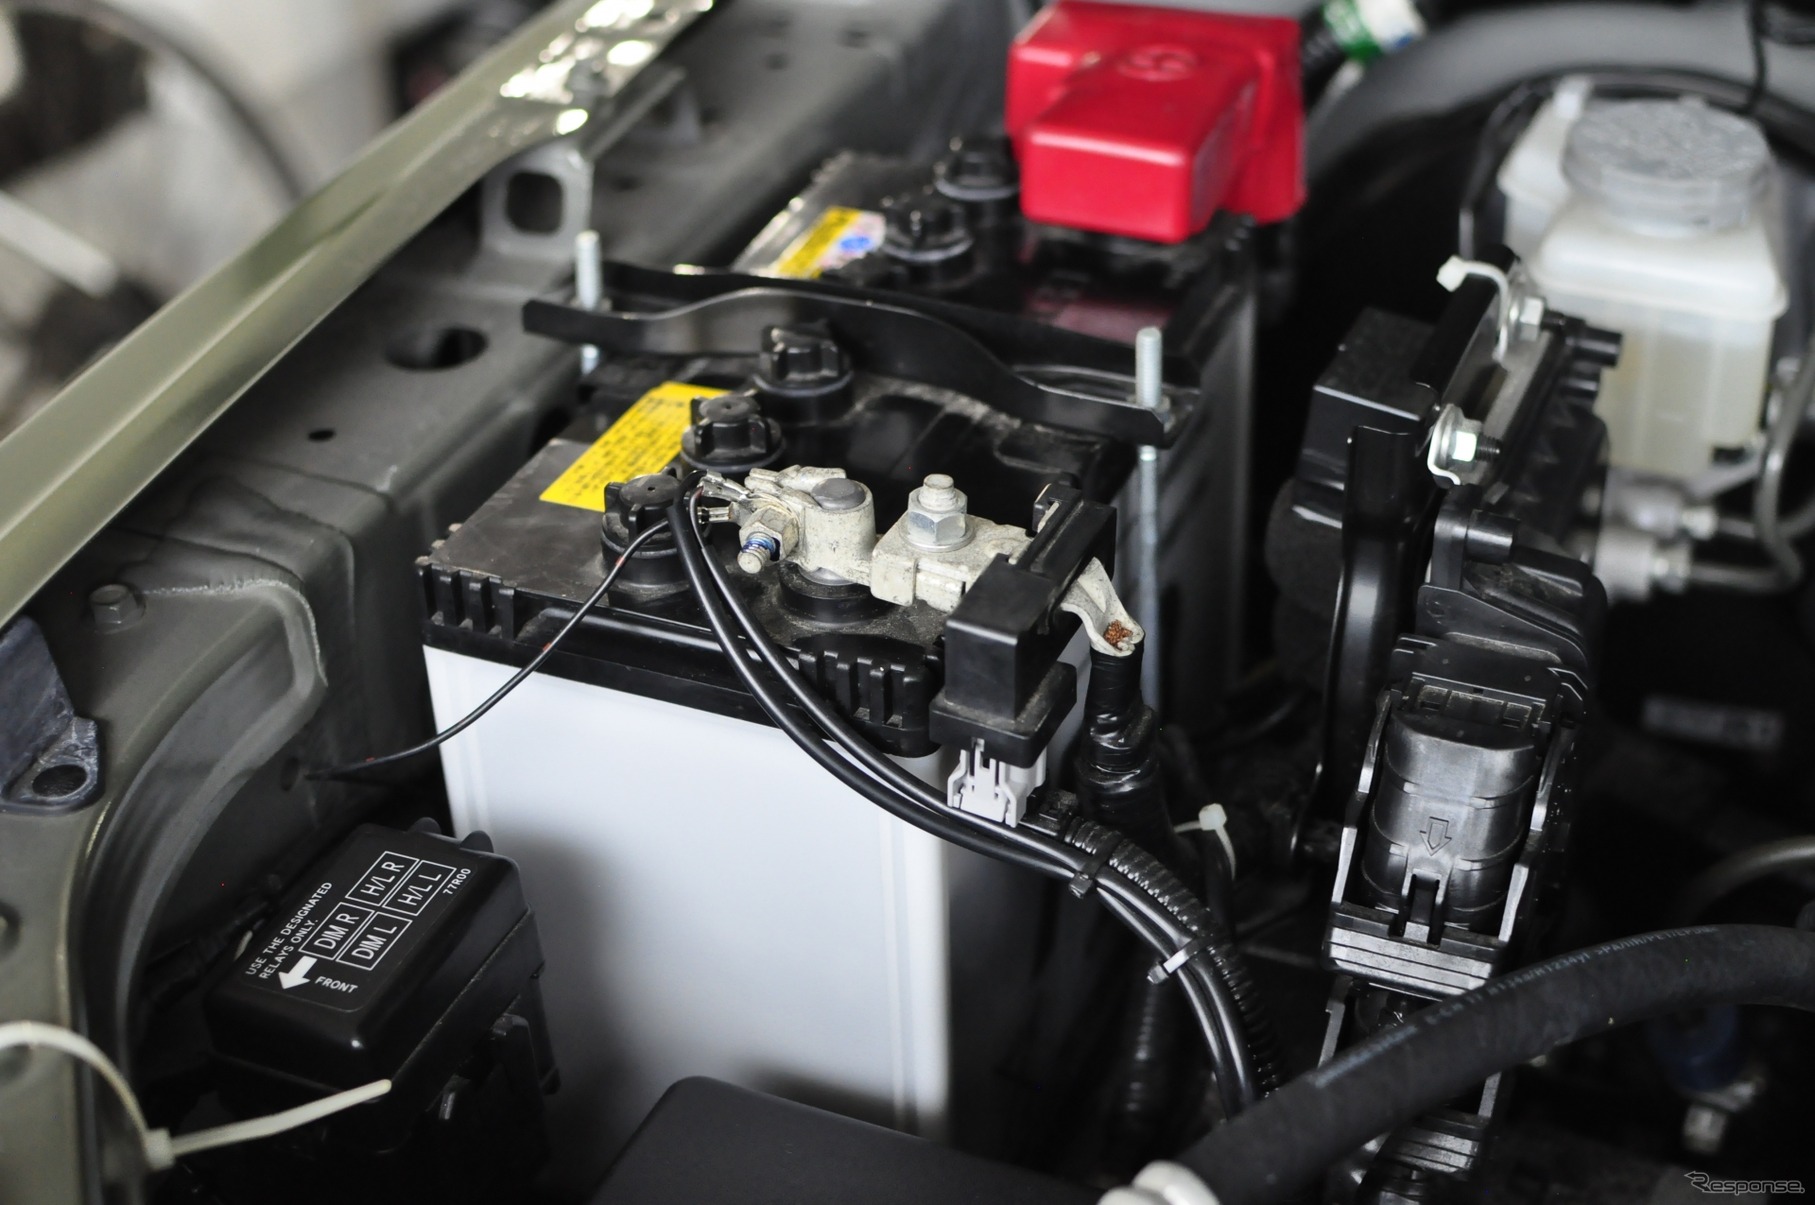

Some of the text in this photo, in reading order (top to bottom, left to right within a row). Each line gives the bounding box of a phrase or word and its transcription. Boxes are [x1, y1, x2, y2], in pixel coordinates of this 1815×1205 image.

[360, 861, 405, 897] H/L R
[397, 873, 442, 906] H/L L
[442, 868, 472, 895] 77R00
[245, 882, 333, 975] USE THE DESIGNATED
[313, 913, 360, 950] DIM R
[351, 926, 398, 960] DIM L
[258, 919, 319, 979] RELAYS ONLY.
[314, 975, 359, 993] FRONT
